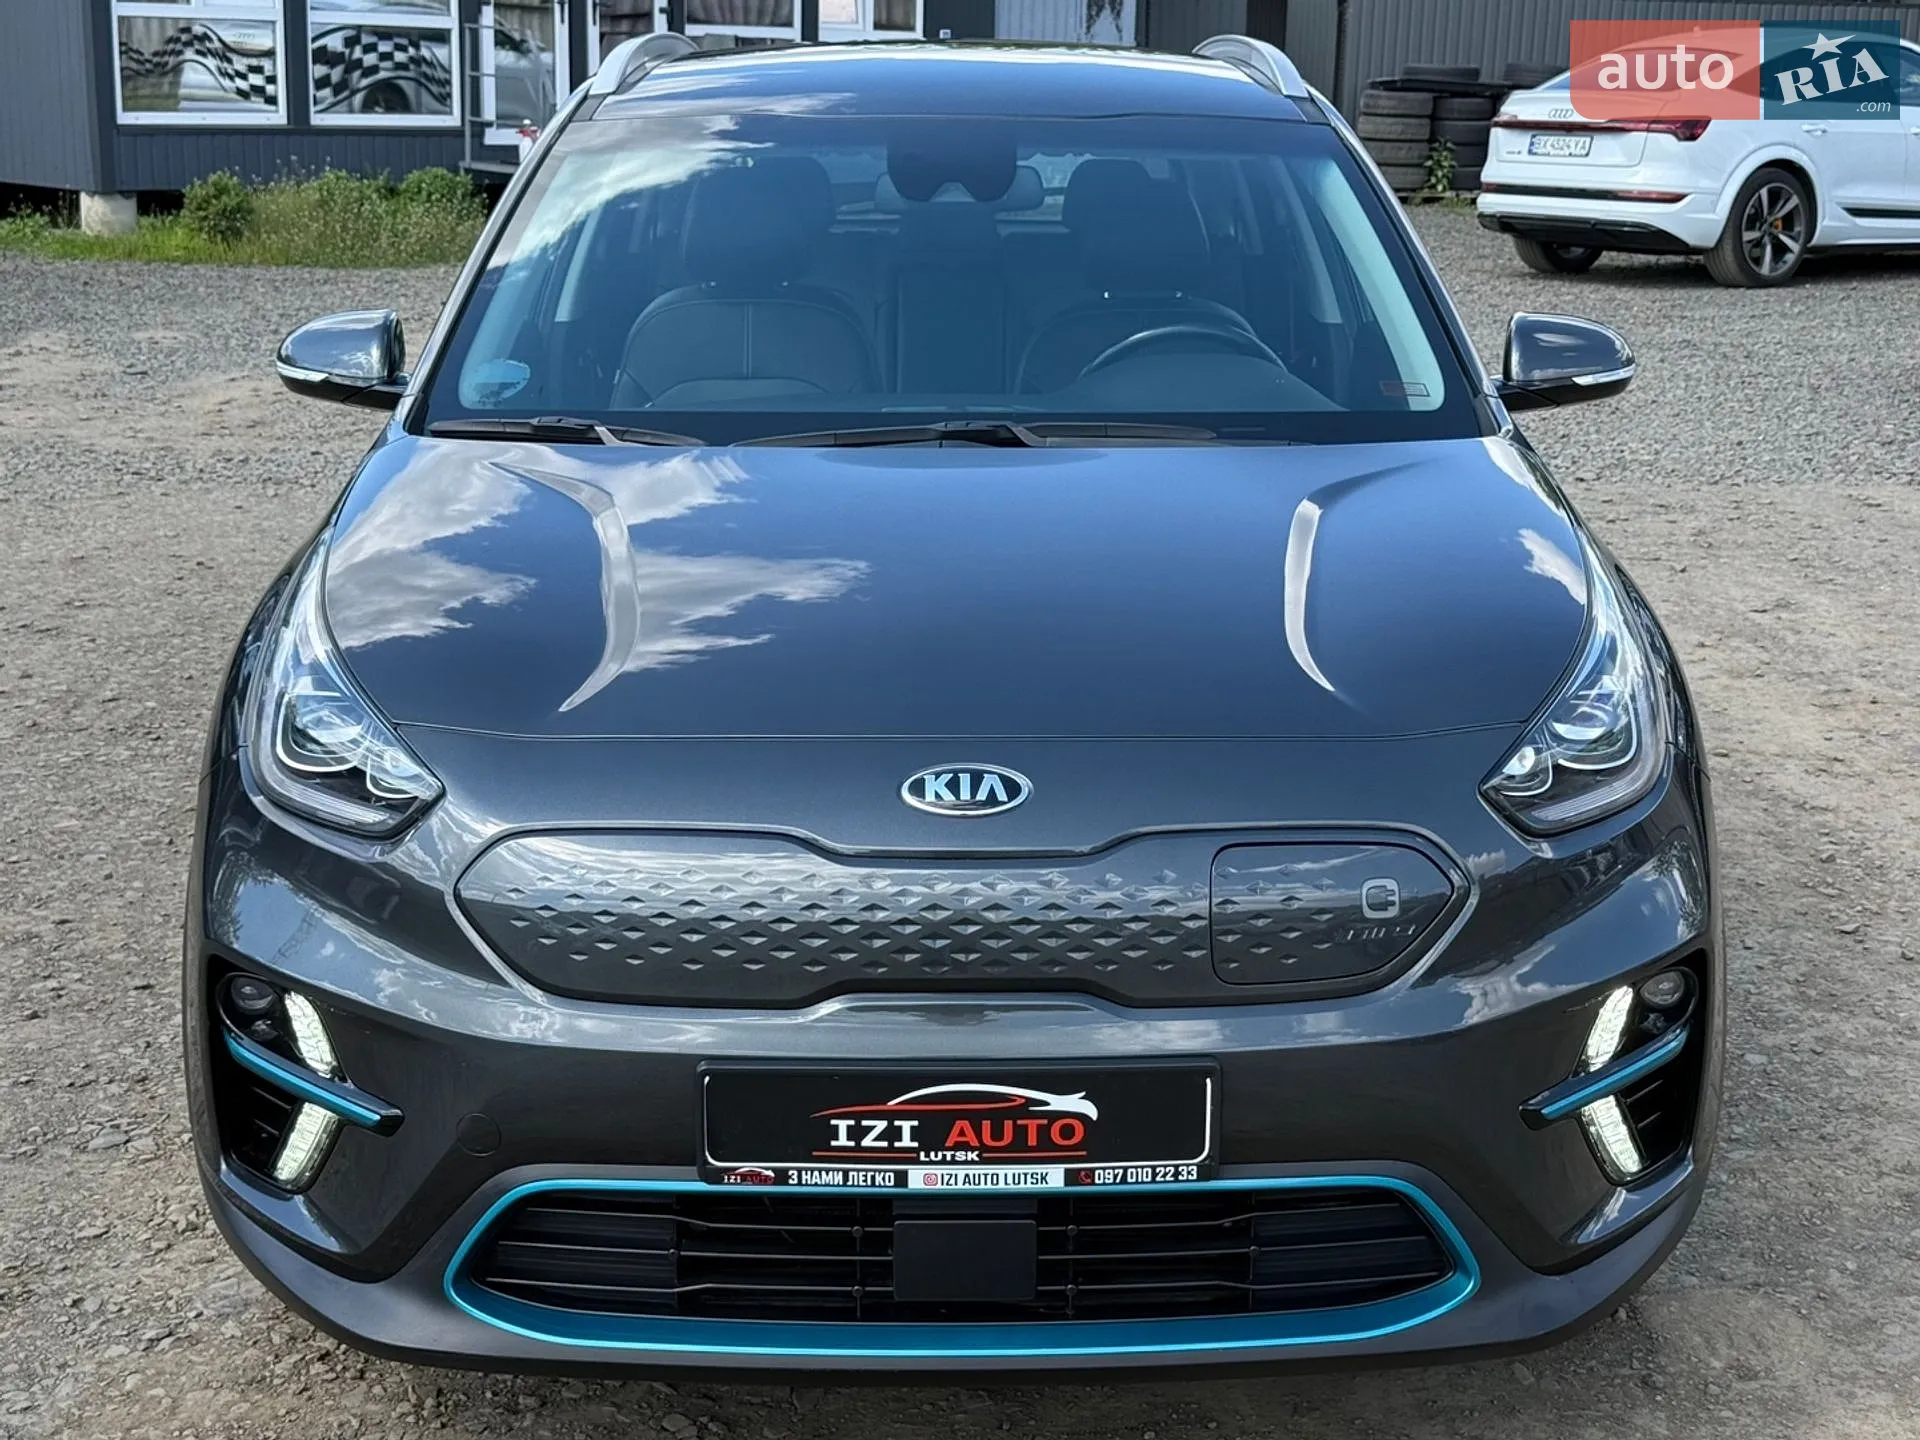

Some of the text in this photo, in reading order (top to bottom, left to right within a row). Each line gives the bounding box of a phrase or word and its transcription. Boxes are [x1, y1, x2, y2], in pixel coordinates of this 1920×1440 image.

[923, 773, 1009, 803] KIA
[830, 1118, 1085, 1148] IZI AUTO
[919, 1150, 980, 1162] LUTSK
[801, 1170, 843, 1186] НАМИ
[847, 1171, 895, 1187] ЛЕГКО
[941, 1171, 1050, 1187] IZI AUTO LUTSK
[1094, 1165, 1198, 1184] 097 010 22 33
